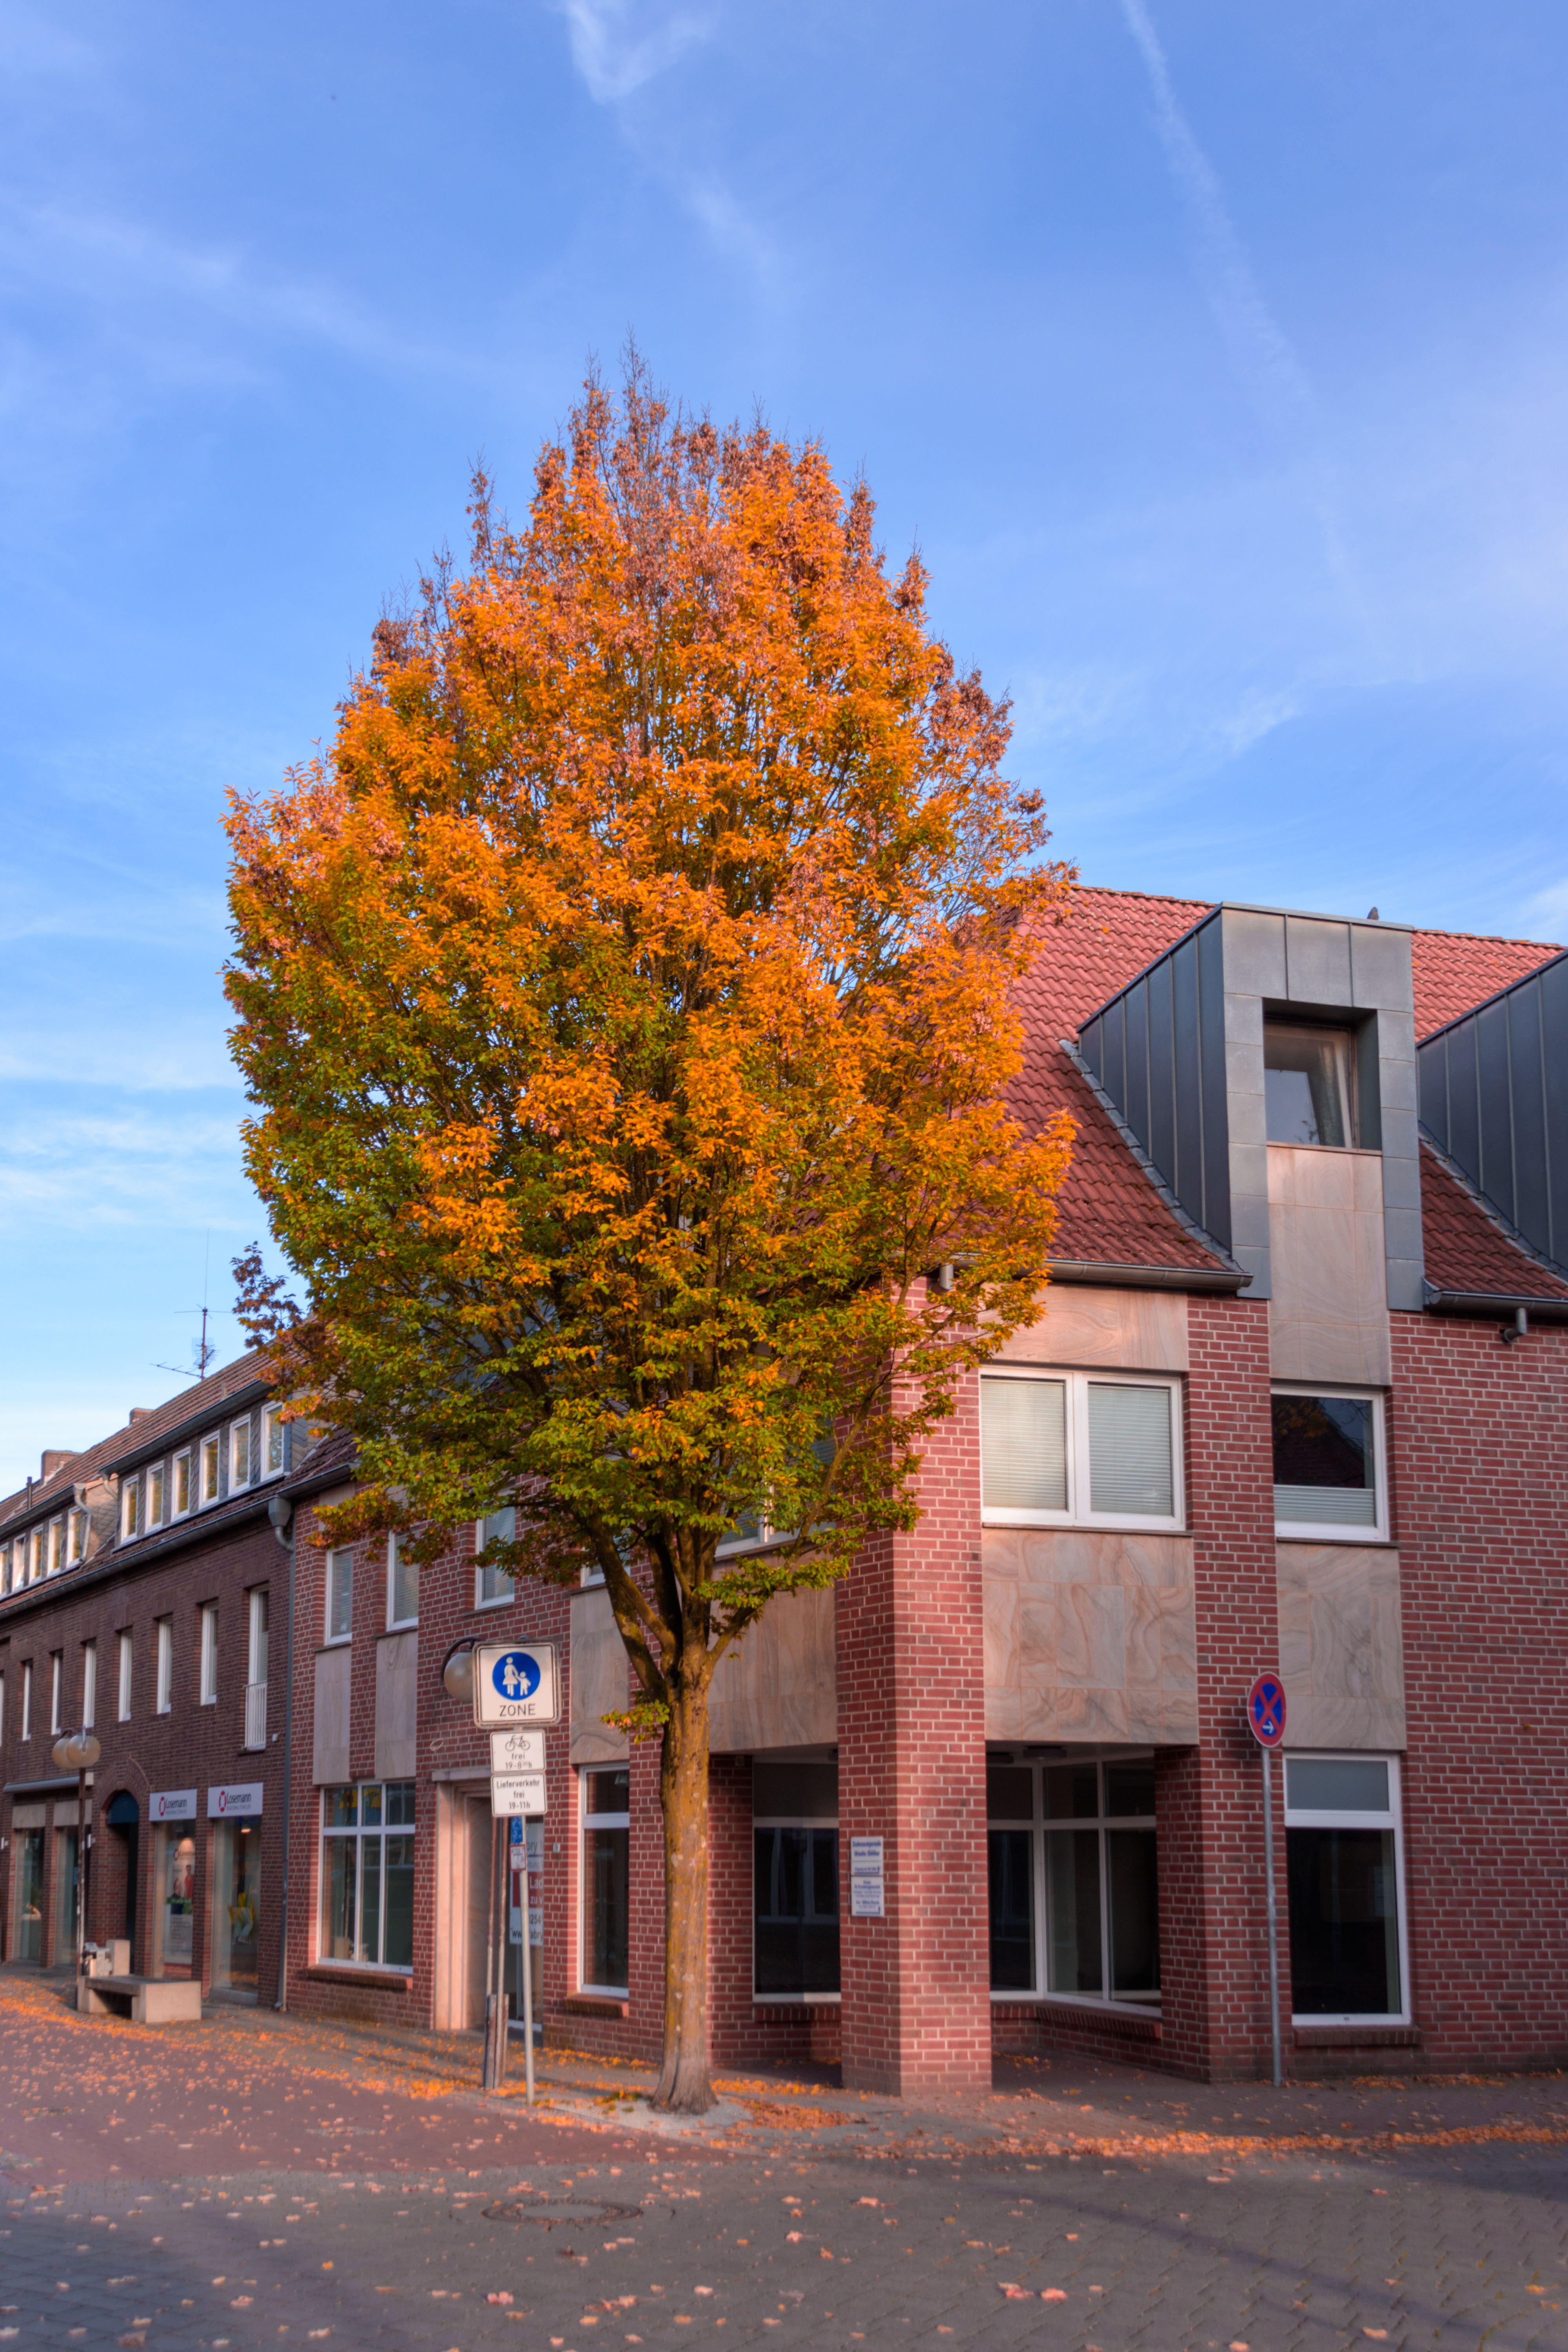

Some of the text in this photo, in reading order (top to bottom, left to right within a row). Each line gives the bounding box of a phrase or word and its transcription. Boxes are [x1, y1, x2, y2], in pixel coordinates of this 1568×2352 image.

[499, 1703, 536, 1717] ZONE
[496, 1779, 539, 1788] Lieferverkehr
[227, 1793, 251, 1804] Losemann
[514, 1790, 524, 1798] frei
[166, 1798, 187, 1809] Losemann
[509, 1801, 530, 1809] 19-11h
